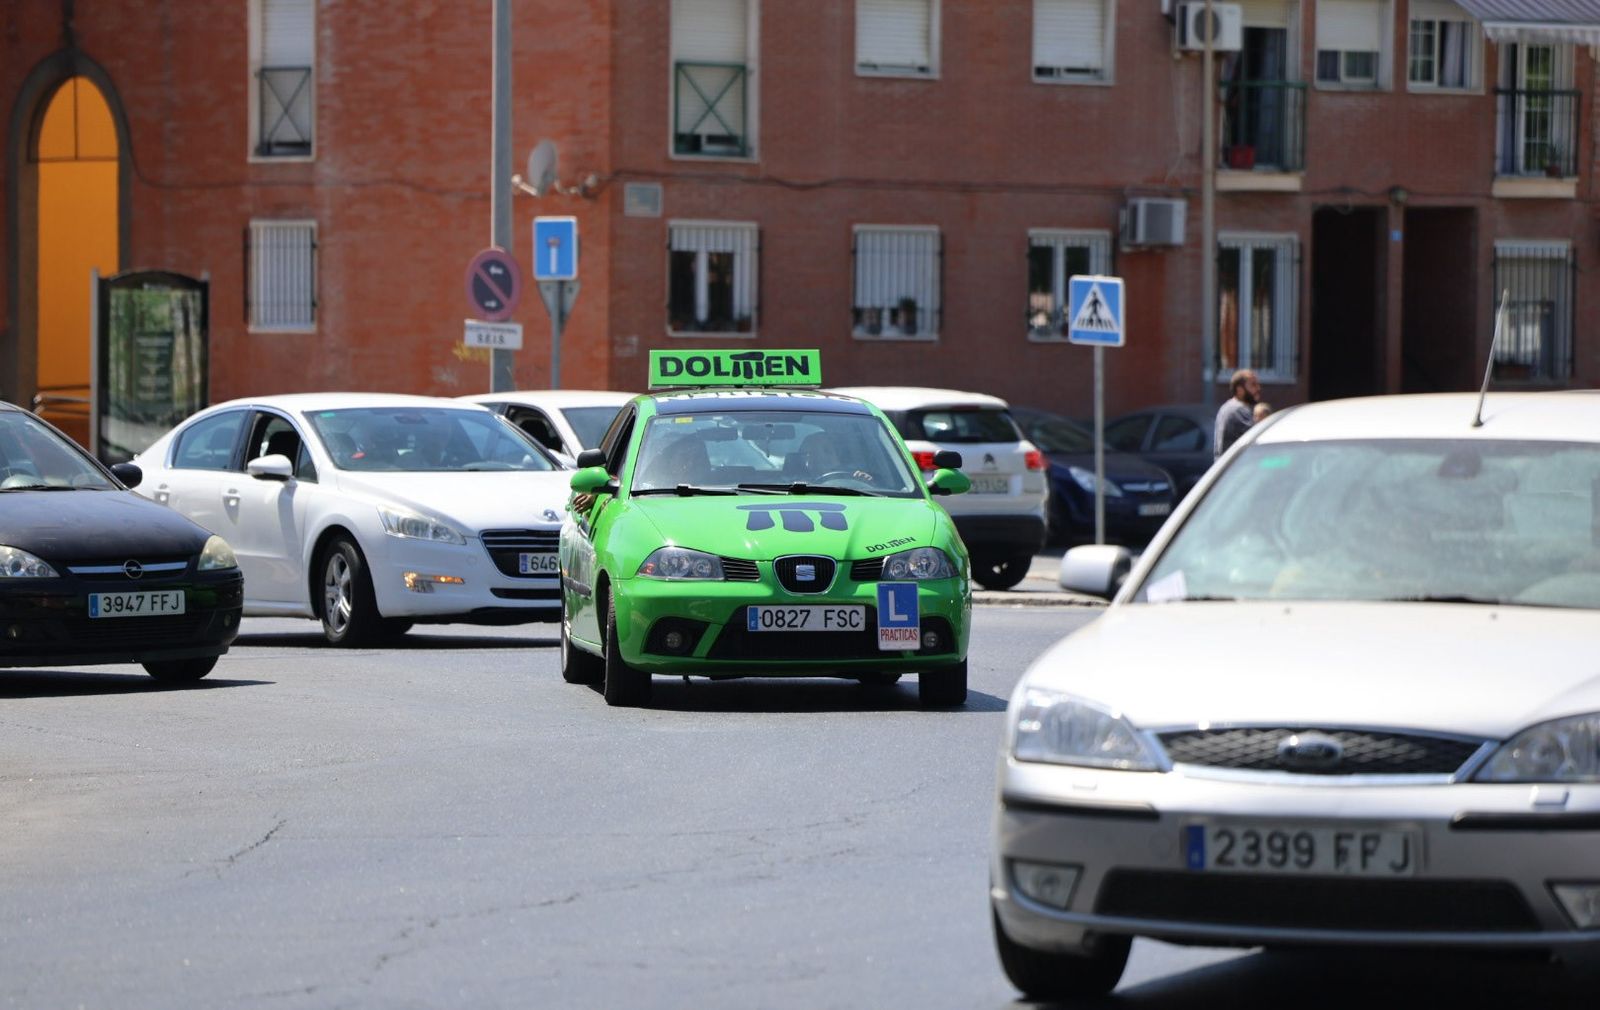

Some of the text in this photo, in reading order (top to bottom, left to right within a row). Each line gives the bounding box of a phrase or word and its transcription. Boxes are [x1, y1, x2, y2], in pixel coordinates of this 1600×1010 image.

[659, 351, 811, 379] DOLMEN
[865, 536, 917, 553] DOLMEN
[103, 593, 180, 613] 3947 FFJ
[888, 590, 909, 621] L
[761, 609, 861, 628] 0827 FSC
[880, 628, 918, 641] PRACTICAS
[1213, 828, 1316, 869] 2399
